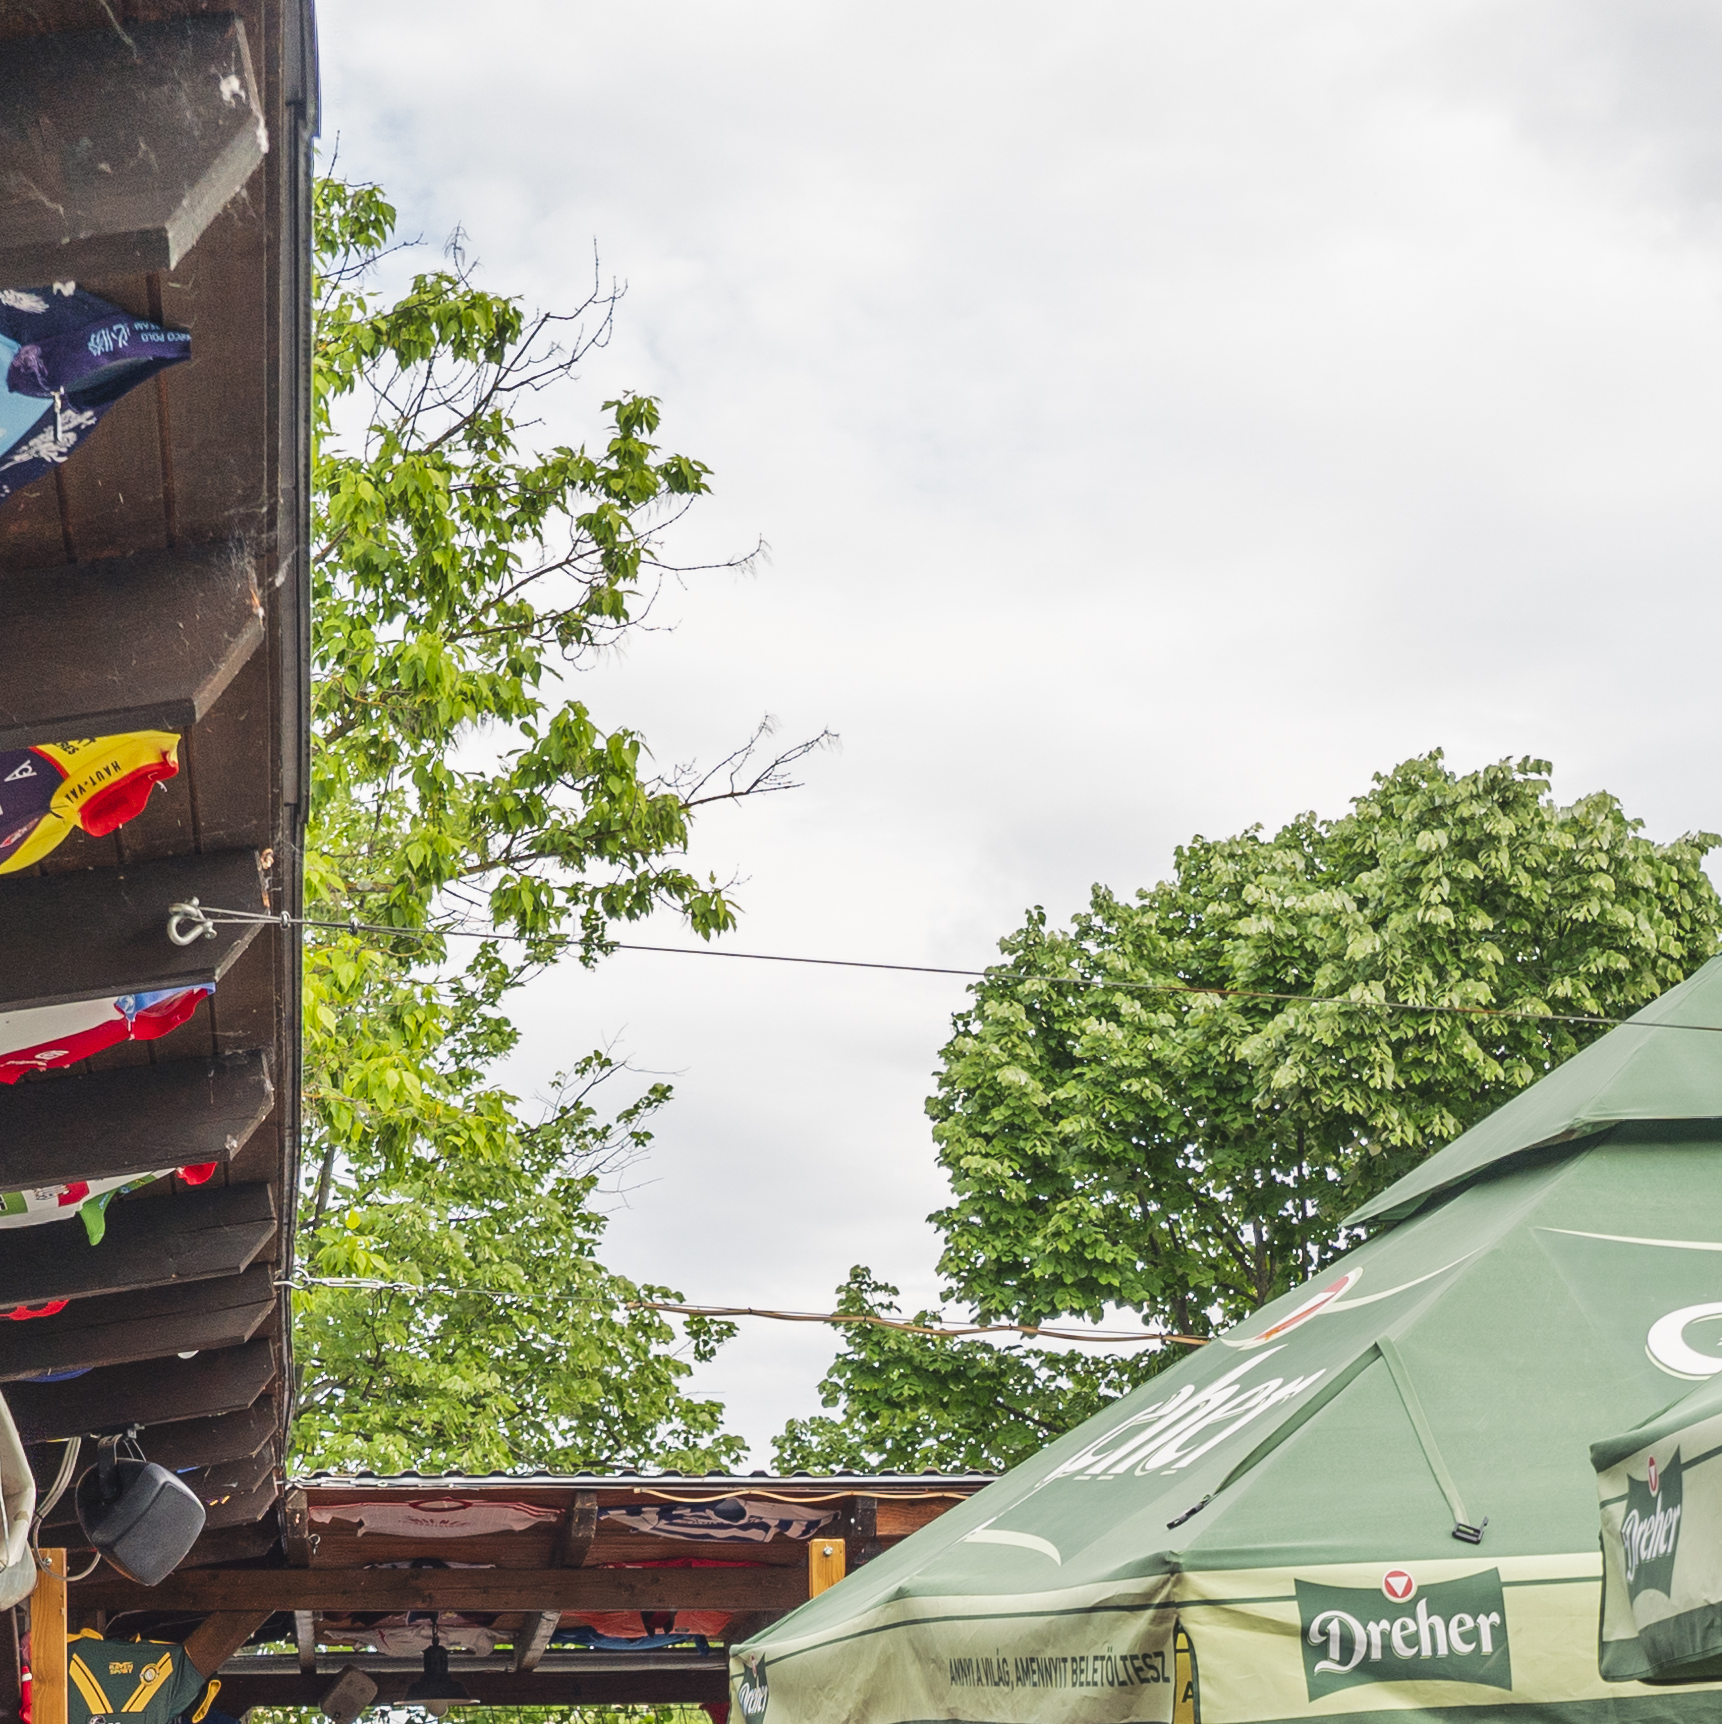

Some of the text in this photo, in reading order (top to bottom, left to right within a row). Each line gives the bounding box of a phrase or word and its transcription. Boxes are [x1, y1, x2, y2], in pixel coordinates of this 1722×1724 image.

[1622, 1480, 1681, 1582] Dreher
[949, 1656, 976, 1687] ANNYI
[1014, 1656, 1068, 1688] AMENNYIT
[1307, 1599, 1502, 1675] Dreher
